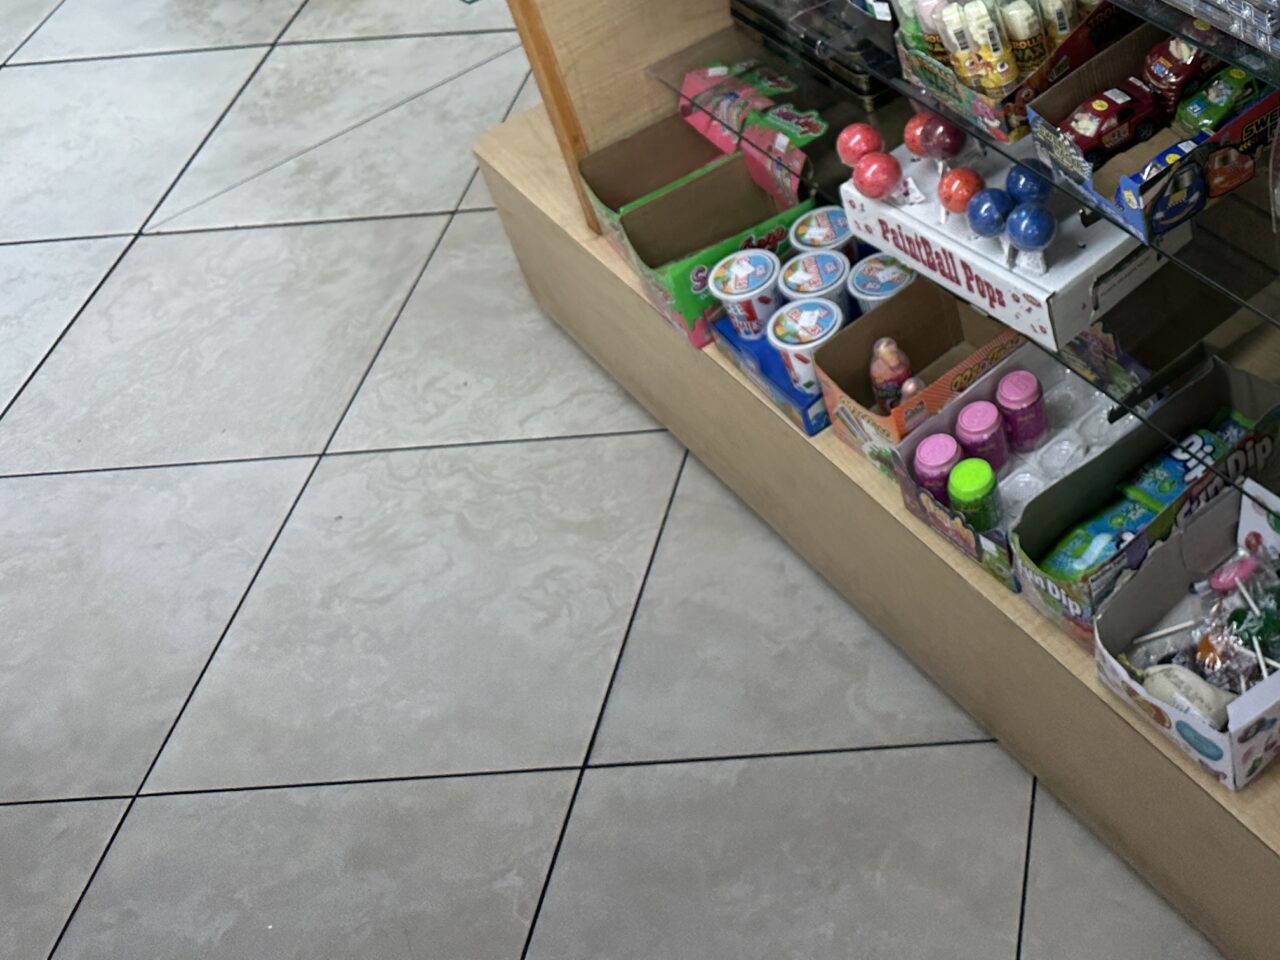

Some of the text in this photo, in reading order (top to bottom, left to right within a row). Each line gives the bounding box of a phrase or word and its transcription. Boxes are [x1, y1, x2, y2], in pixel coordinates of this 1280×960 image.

[878, 218, 1006, 309] PaintBall Pops
[1226, 436, 1273, 480] Dip
[1047, 583, 1083, 617] Dip
